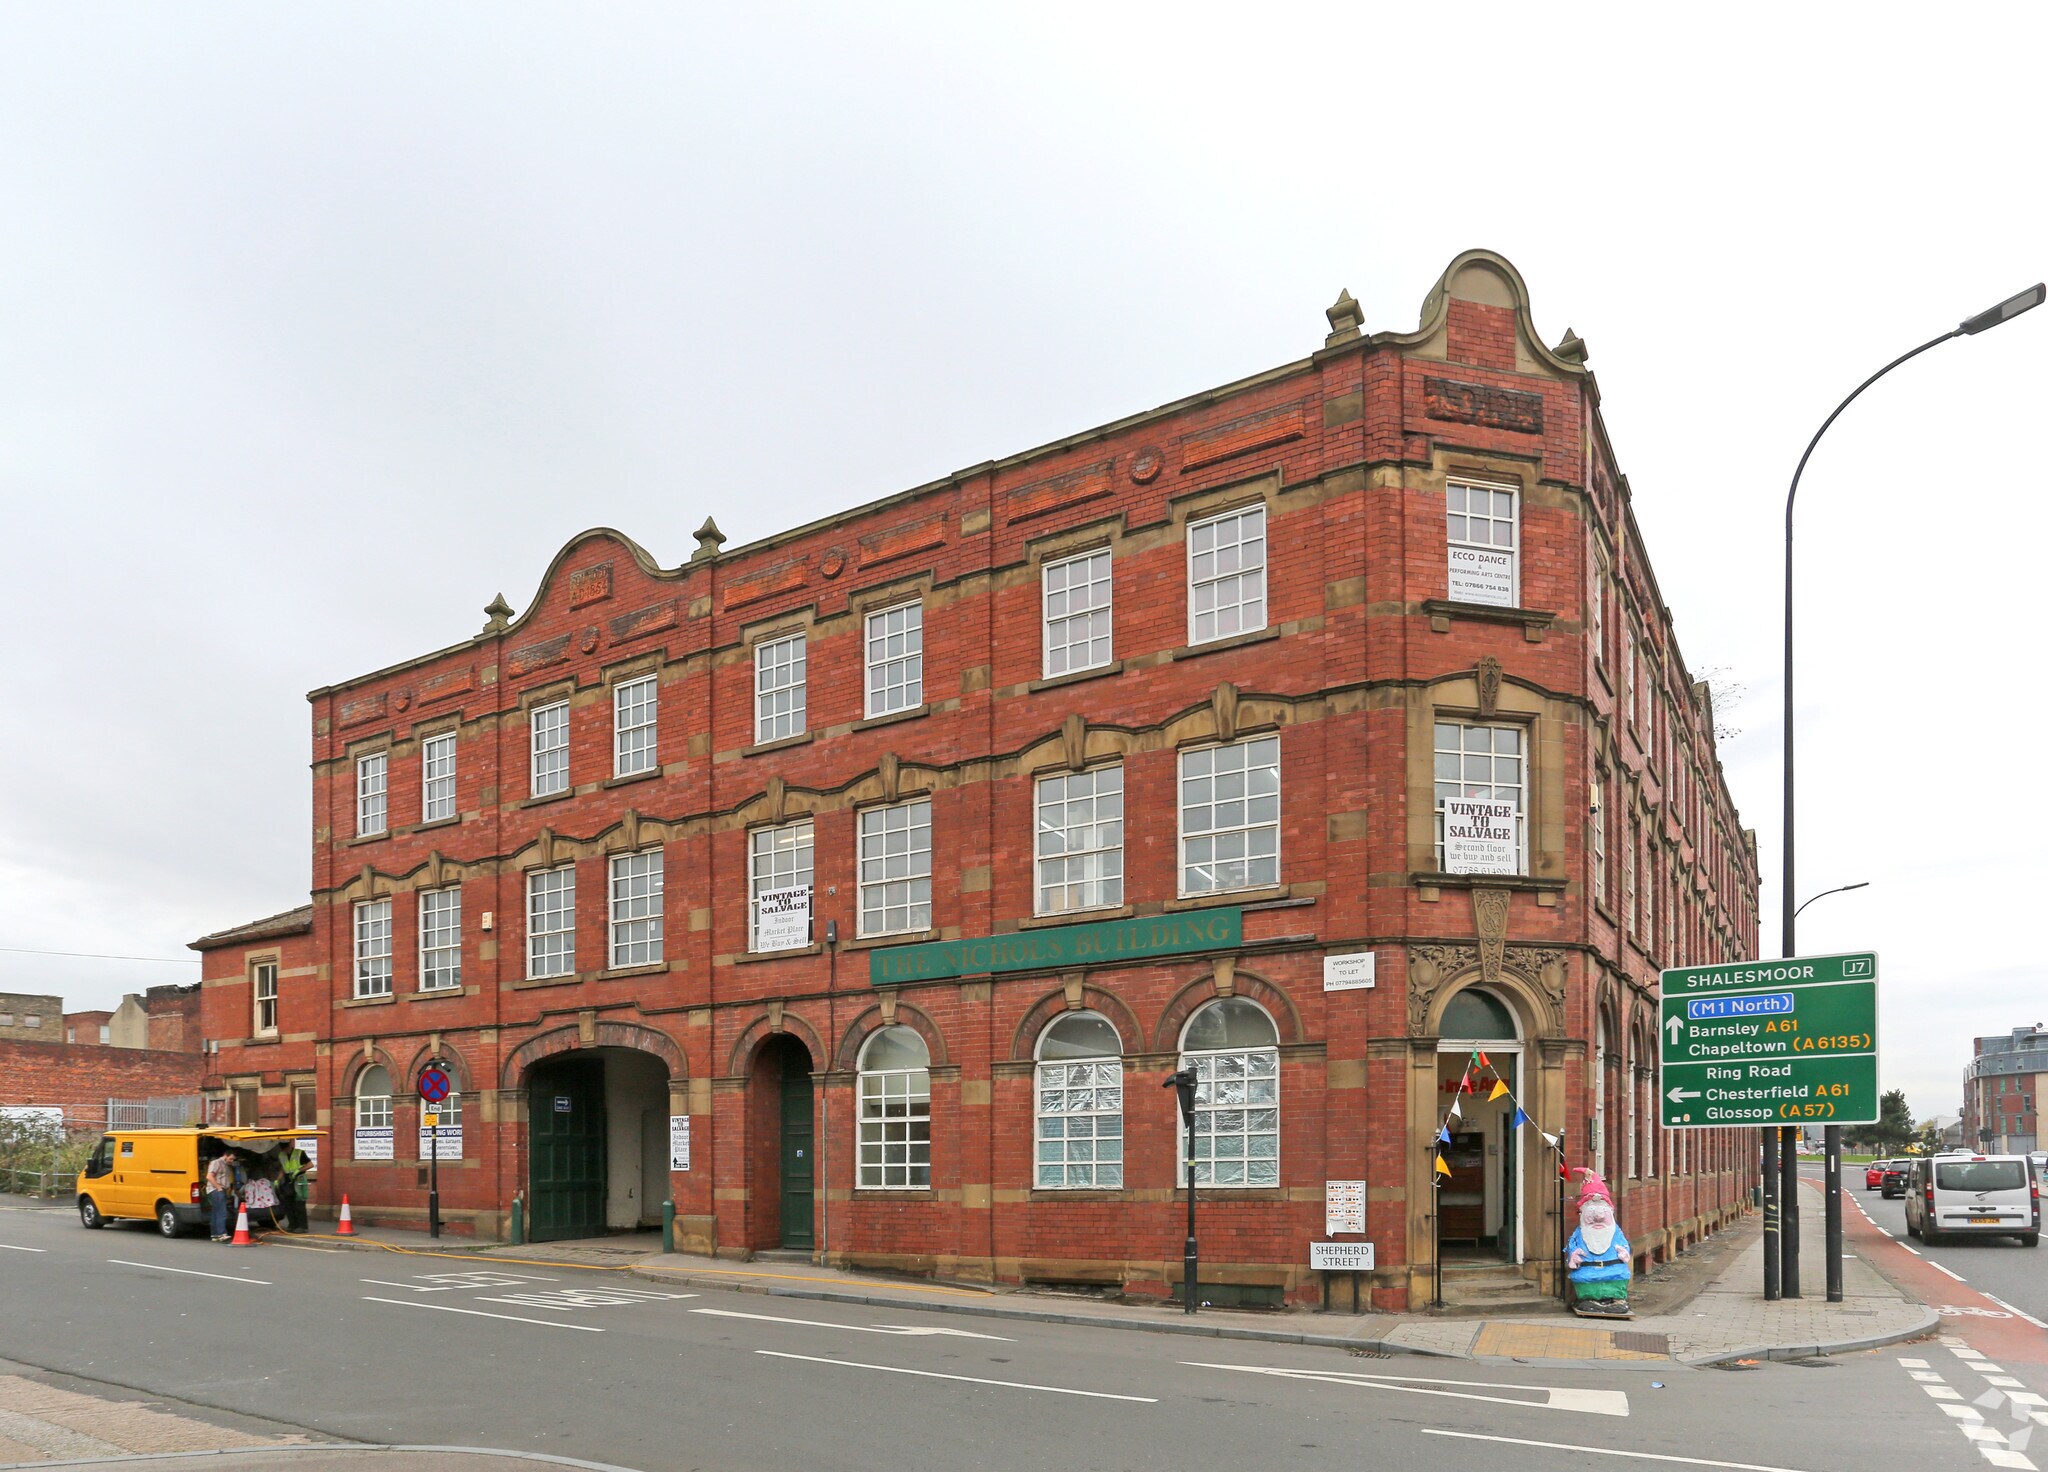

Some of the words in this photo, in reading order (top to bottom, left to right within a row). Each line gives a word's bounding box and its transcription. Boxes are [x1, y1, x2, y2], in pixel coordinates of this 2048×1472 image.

[1452, 551, 1475, 561] ECCO
[1478, 554, 1507, 565] DANCE
[1449, 567, 1480, 576] PERFORMING
[1450, 803, 1511, 818] VINTAGE
[1470, 815, 1489, 827] TO
[1449, 825, 1511, 840] SALVAGE
[1454, 842, 1485, 852] Second
[1487, 844, 1506, 852] floor
[1450, 852, 1461, 860] we
[1463, 852, 1478, 860] buy
[1480, 853, 1495, 861] and
[1497, 854, 1511, 862] sell
[761, 889, 807, 903] VINTAGE
[776, 898, 792, 906] TO
[761, 902, 807, 914] SALVAGE
[878, 951, 930, 978] THE
[942, 936, 1064, 971] NICHOLS
[1075, 916, 1231, 956] BUILDING
[1333, 958, 1366, 966] WORKSHOP
[1687, 966, 1815, 988] SHALESMOOR
[1848, 962, 1866, 974] J7
[1731, 995, 1791, 1013] North)
[1689, 1022, 1760, 1038] Barnsley
[1688, 1040, 1787, 1057] Chapeltown
[1706, 1066, 1742, 1081] Ring
[1749, 1064, 1792, 1078] Road
[1706, 1085, 1809, 1101] Chesterfield
[1706, 1106, 1773, 1120] Glossop
[1315, 1245, 1369, 1256] SHEPHERD
[1322, 1257, 1361, 1267] STREET
